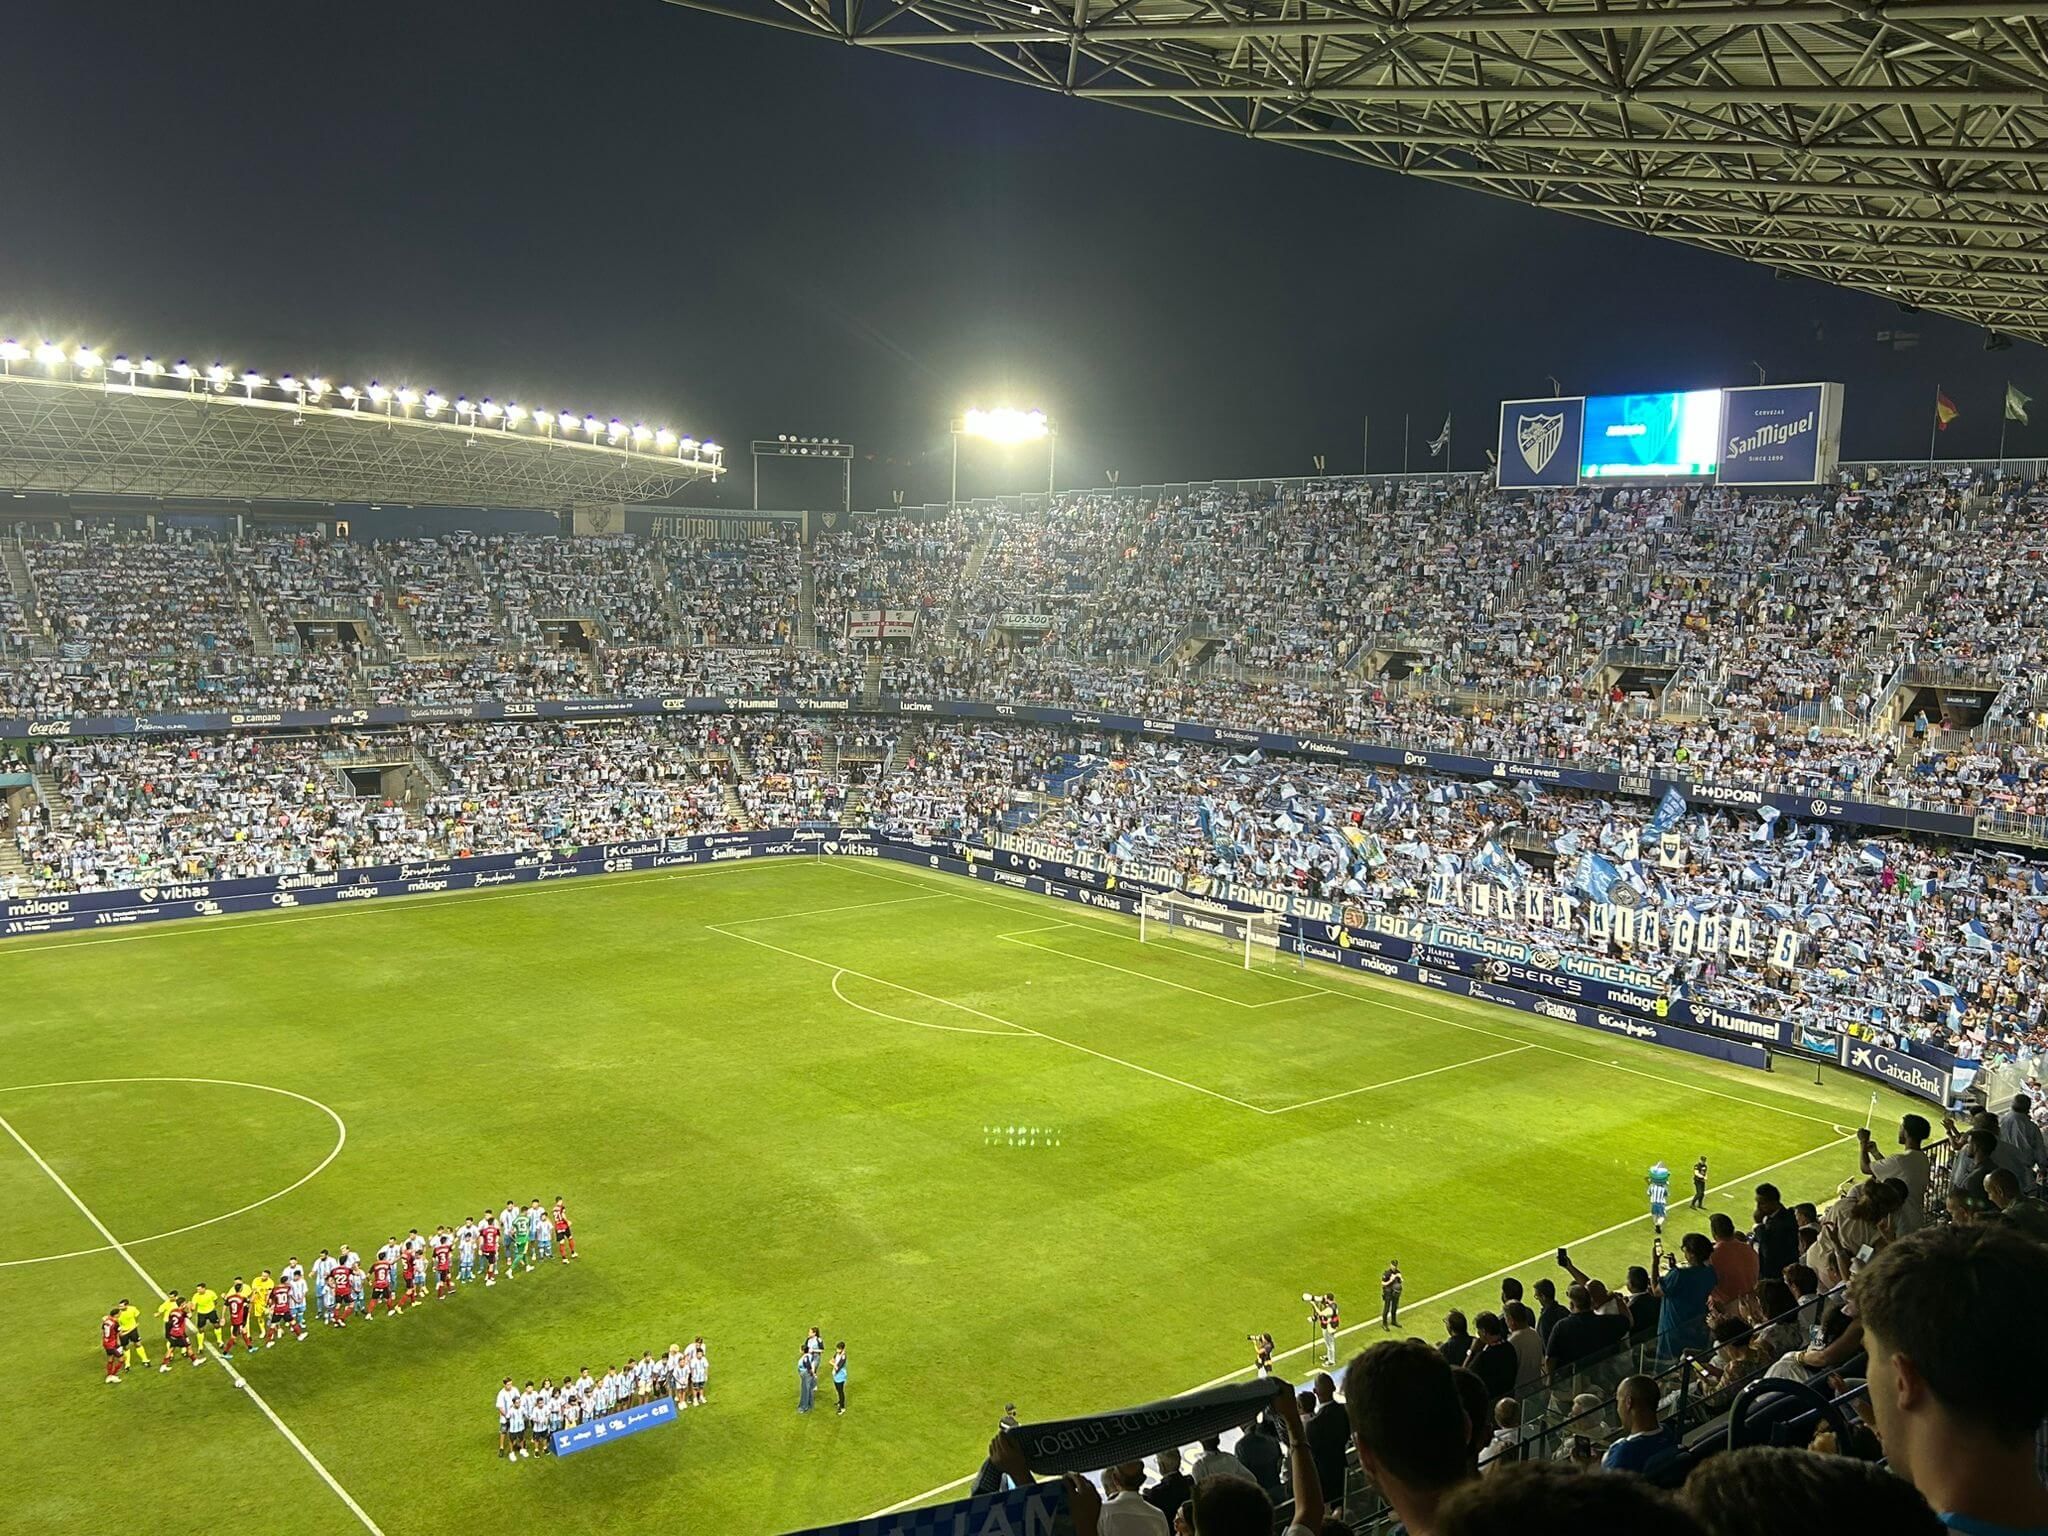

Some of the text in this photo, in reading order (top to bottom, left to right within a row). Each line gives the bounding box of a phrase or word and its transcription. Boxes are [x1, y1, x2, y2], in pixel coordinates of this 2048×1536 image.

[504, 703, 537, 714] SUR
[738, 698, 778, 709] hummel
[809, 699, 848, 709] hummel
[246, 714, 281, 723] campano
[1509, 765, 1560, 779] divina events
[620, 843, 659, 855] CaixaBank
[840, 842, 879, 856] vithas
[1001, 833, 1074, 865] HEREDEROS
[1076, 849, 1094, 869] DE
[408, 878, 447, 891] málaga
[161, 884, 209, 900] vithas
[337, 885, 377, 898] málaga
[9, 900, 69, 916] málaga
[1091, 894, 1120, 910] vithas
[1228, 883, 1424, 940] FONDO SUR 1904
[1428, 946, 1455, 959] HARPER
[1438, 929, 1665, 989] MALAKA HINCHAS
[1361, 955, 1398, 976] málaga
[1512, 967, 1582, 991] SERES
[1711, 1010, 1780, 1041] hummel
[1875, 1053, 1941, 1097] CaixaBank
[517, 1220, 527, 1231] 13
[486, 1231, 494, 1243] 5
[334, 1274, 348, 1285] 22
[277, 1293, 288, 1305] 10
[231, 1302, 238, 1315] 9
[172, 1316, 179, 1328] 2
